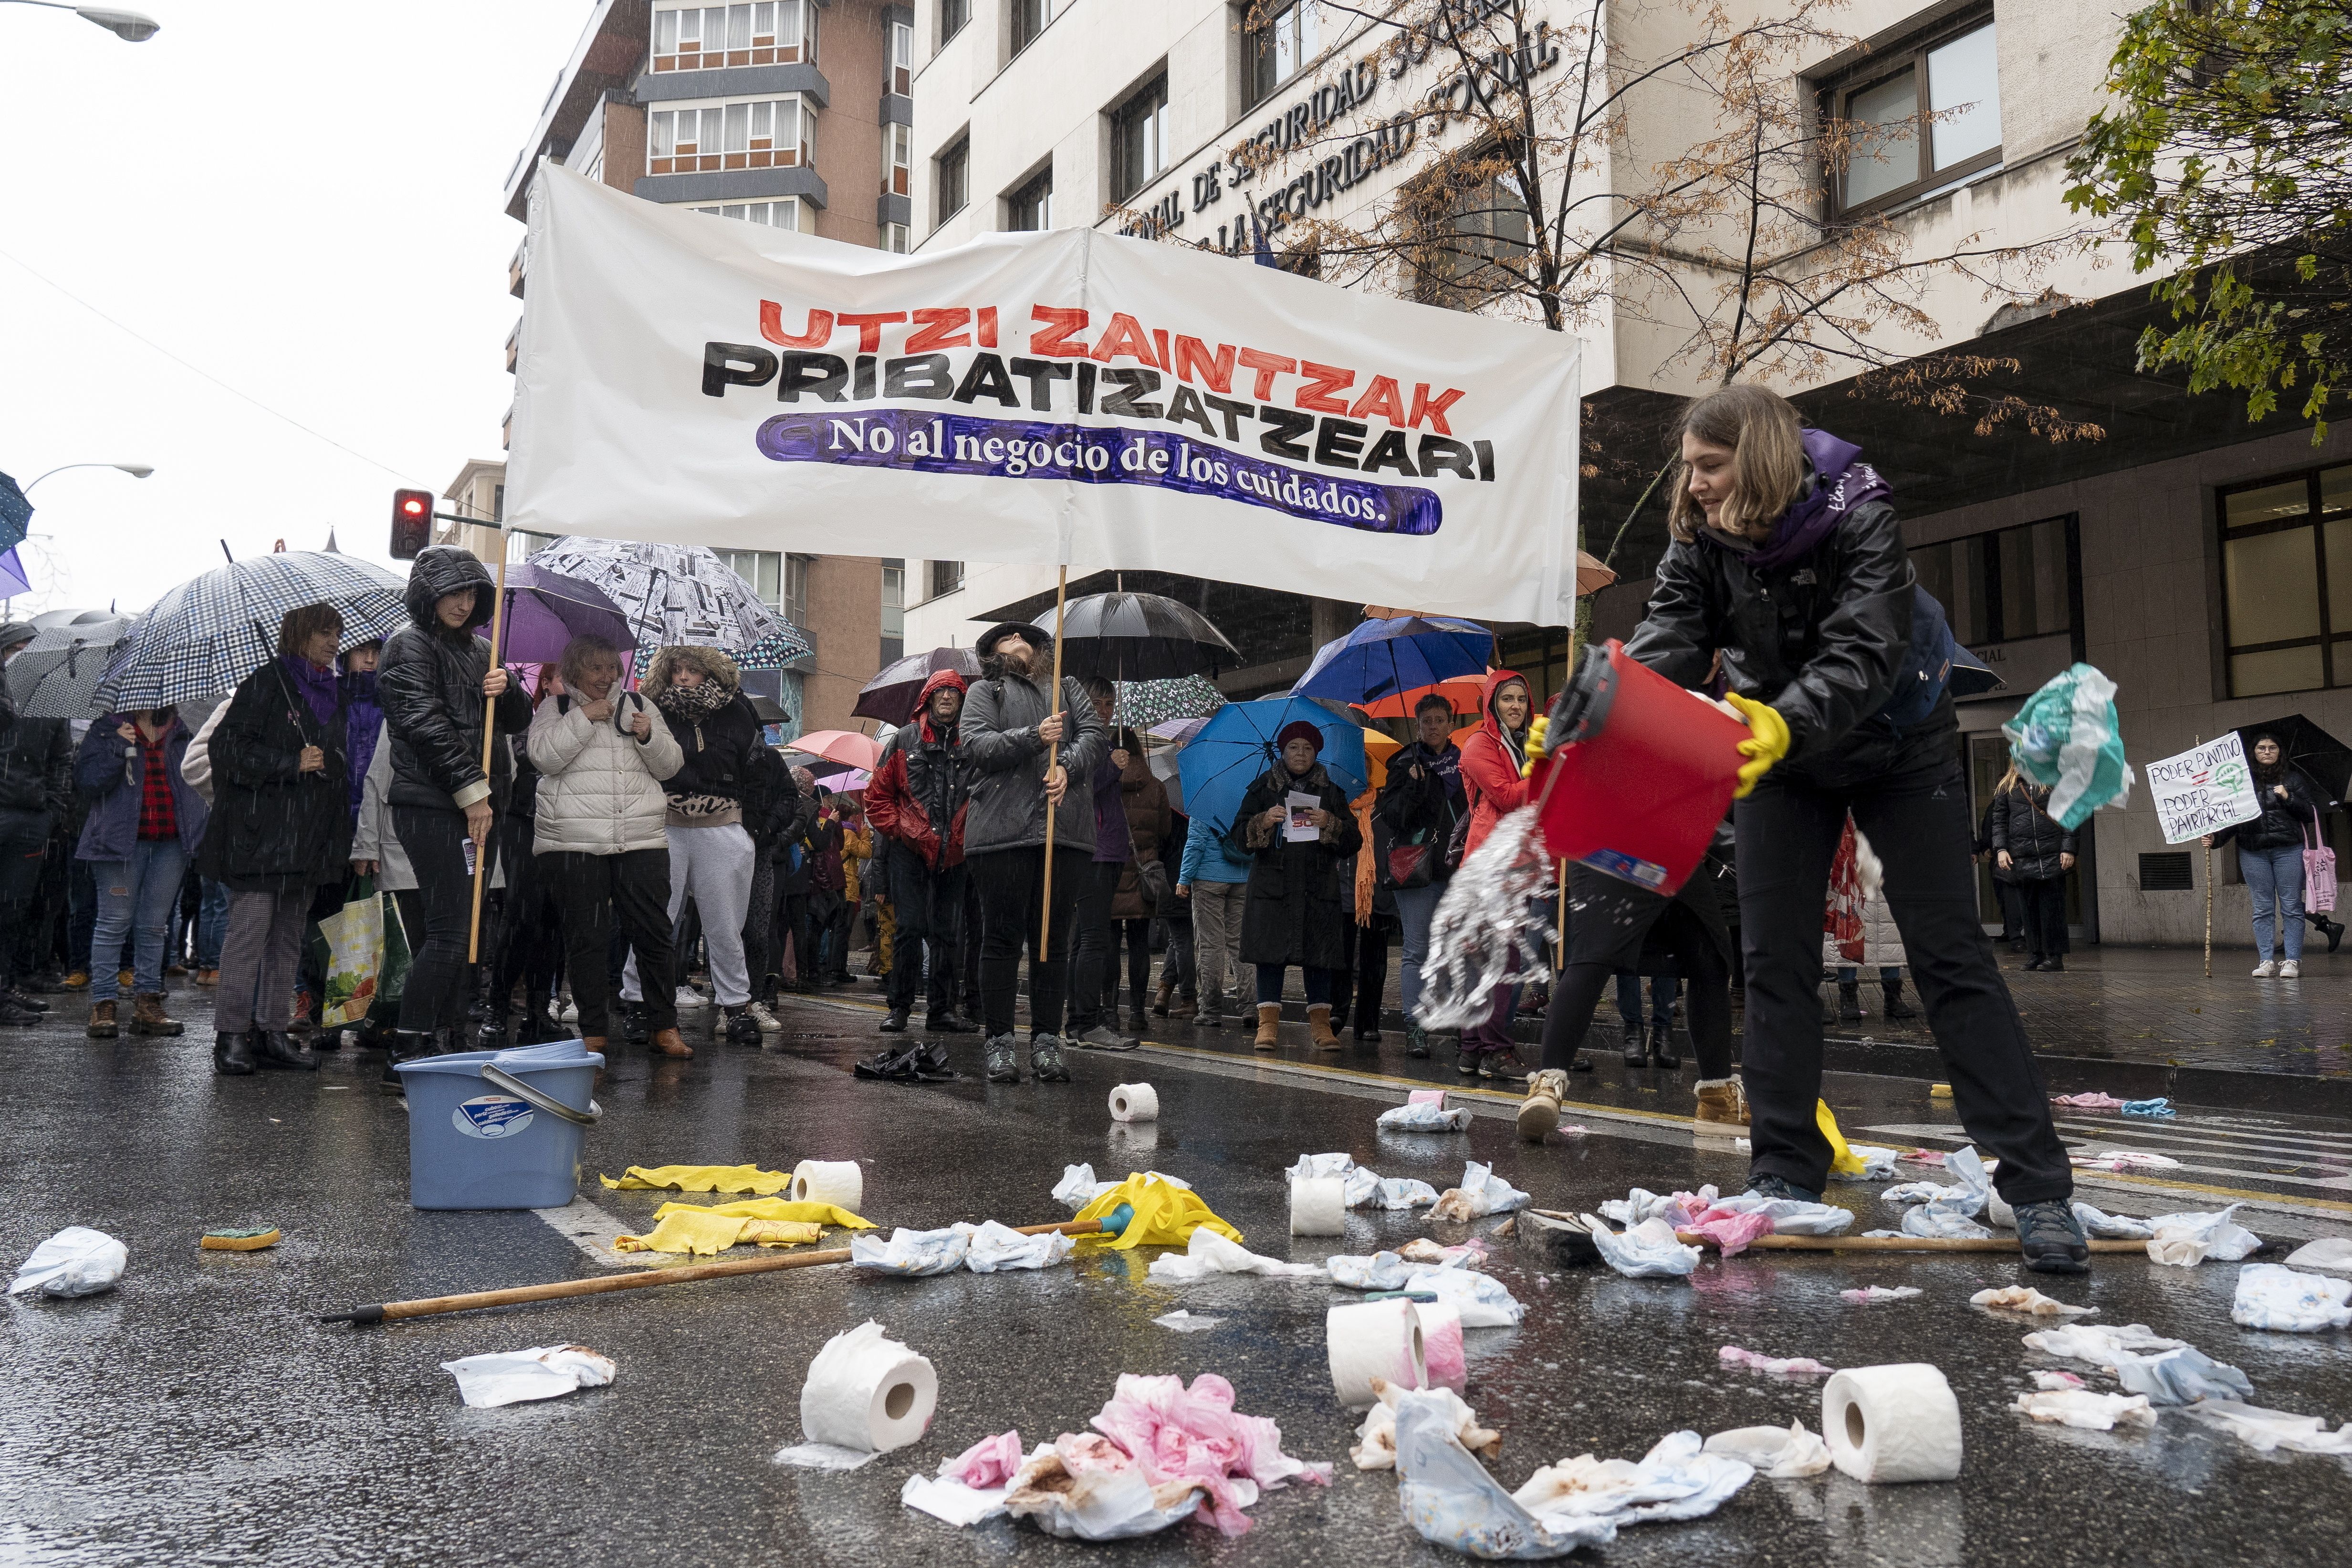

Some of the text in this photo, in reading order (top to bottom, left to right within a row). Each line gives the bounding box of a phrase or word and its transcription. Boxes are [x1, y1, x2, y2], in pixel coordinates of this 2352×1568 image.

[1114, 190, 1184, 241] ONAL
[1192, 162, 1221, 213] DE
[1228, 60, 1378, 188] SEGURIDAD
[1218, 20, 1559, 256] LA SEGURIDAD SOCIAL
[702, 341, 1495, 482] PRIBATIZATZEARI
[760, 299, 1465, 437] UTZI ZAINTZAK
[828, 417, 1387, 522] No al negocio de los cuidados.
[1976, 648, 2006, 663] CIAL
[2151, 738, 2240, 784] PODER PUNITIVO
[2163, 789, 2209, 815] PODER
[2168, 800, 2241, 836] PATRIARCAL
